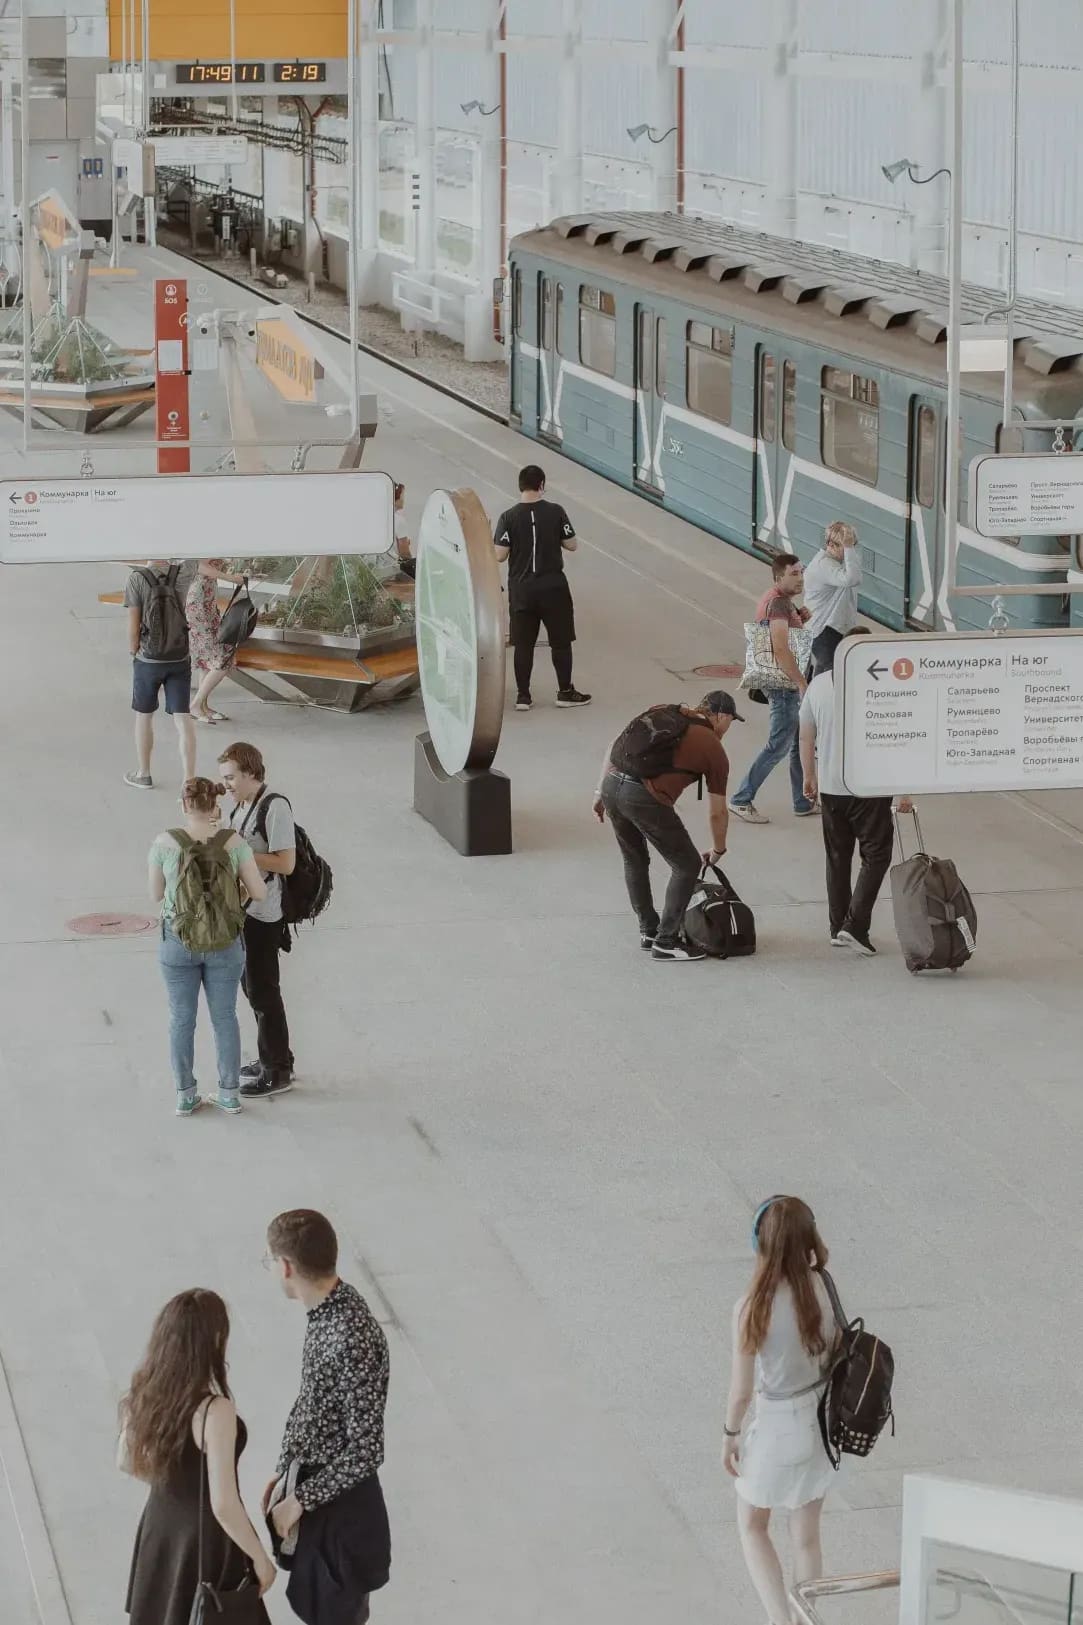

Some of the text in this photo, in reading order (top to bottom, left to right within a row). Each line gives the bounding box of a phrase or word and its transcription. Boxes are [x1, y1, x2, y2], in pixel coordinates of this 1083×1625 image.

[281, 65, 318, 80] 2:19
[40, 489, 89, 499] Коммунарка
[563, 524, 573, 536] R
[500, 531, 510, 542] A
[919, 656, 1002, 671] Коммунарка
[1011, 654, 1048, 666] На юг
[866, 689, 918, 699] Прокшино
[947, 686, 1000, 697] Саларьево
[1024, 684, 1071, 695] Проспект
[865, 710, 913, 719] Ольховая
[947, 706, 1001, 718] Румянцево
[865, 731, 927, 742] Коммунарка
[946, 727, 999, 739] Тропарёво
[1023, 735, 1078, 746] Воробьёвы
[946, 748, 1016, 758] Юго-Западная
[1022, 755, 1080, 766] Спортивная
